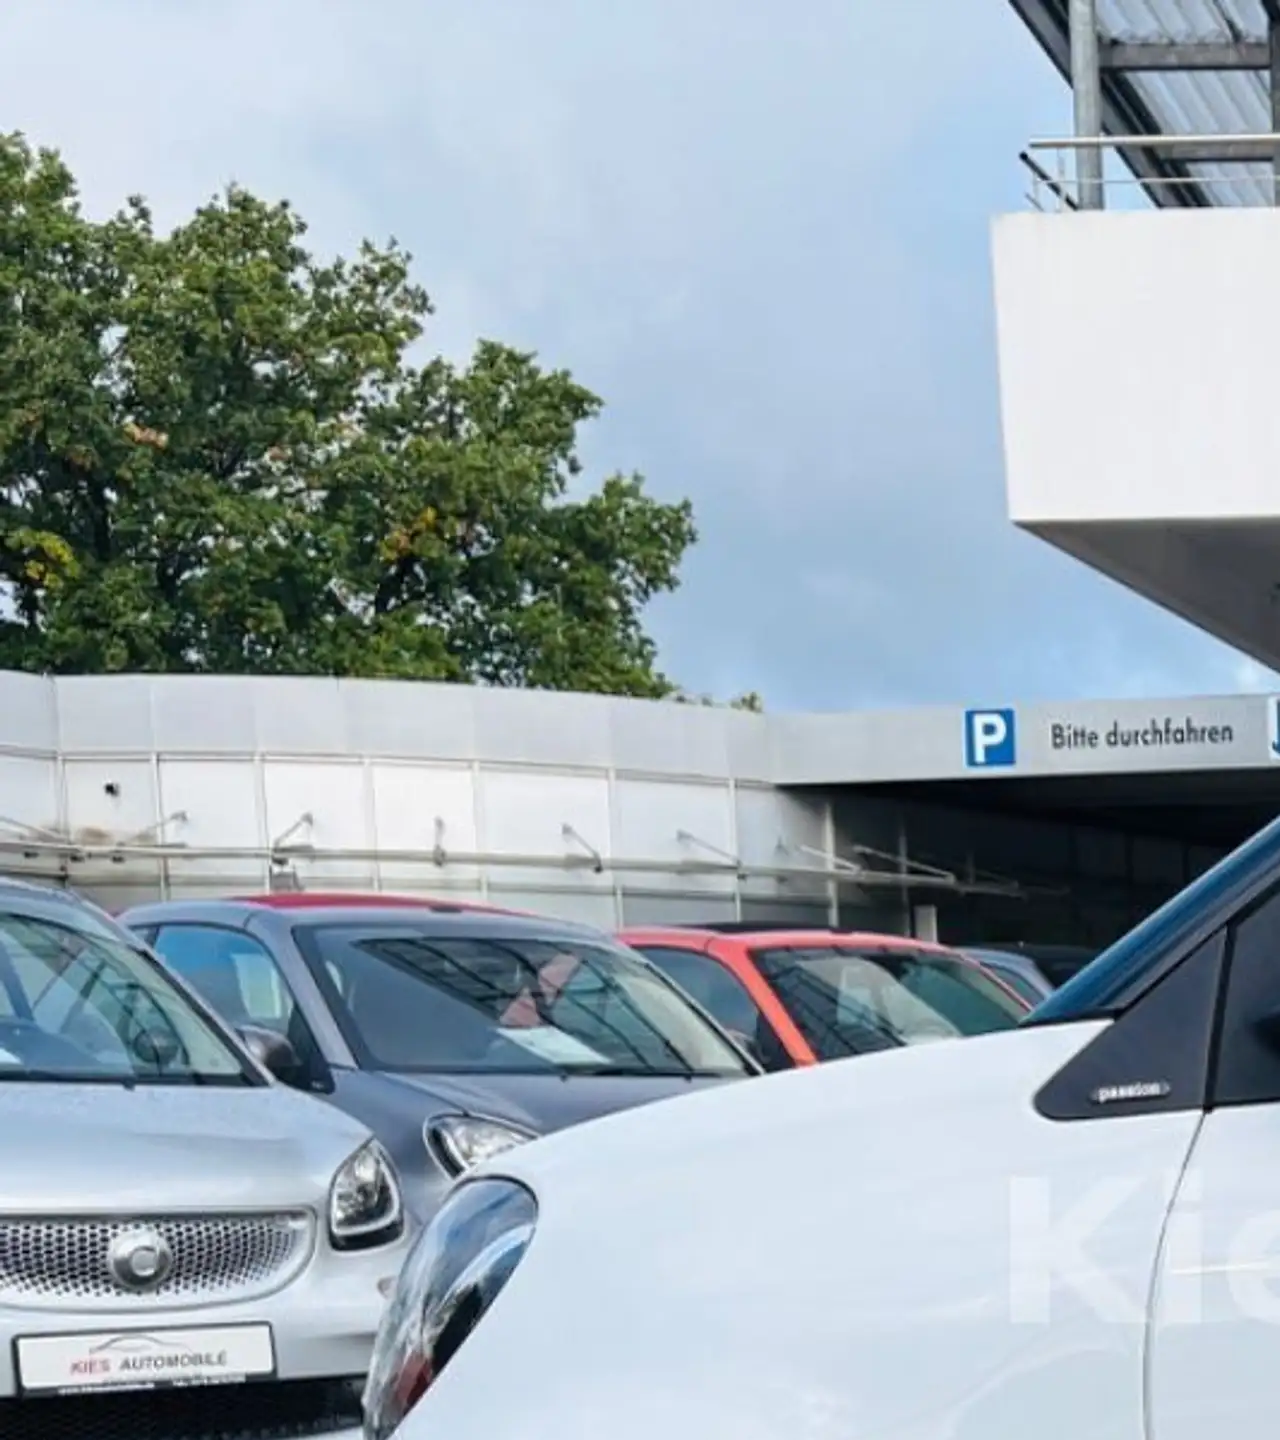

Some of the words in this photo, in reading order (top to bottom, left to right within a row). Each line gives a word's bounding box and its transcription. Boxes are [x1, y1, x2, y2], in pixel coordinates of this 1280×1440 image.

[973, 712, 1006, 763] P
[1050, 722, 1099, 750] Bitte
[1105, 715, 1233, 748] durchfahren
